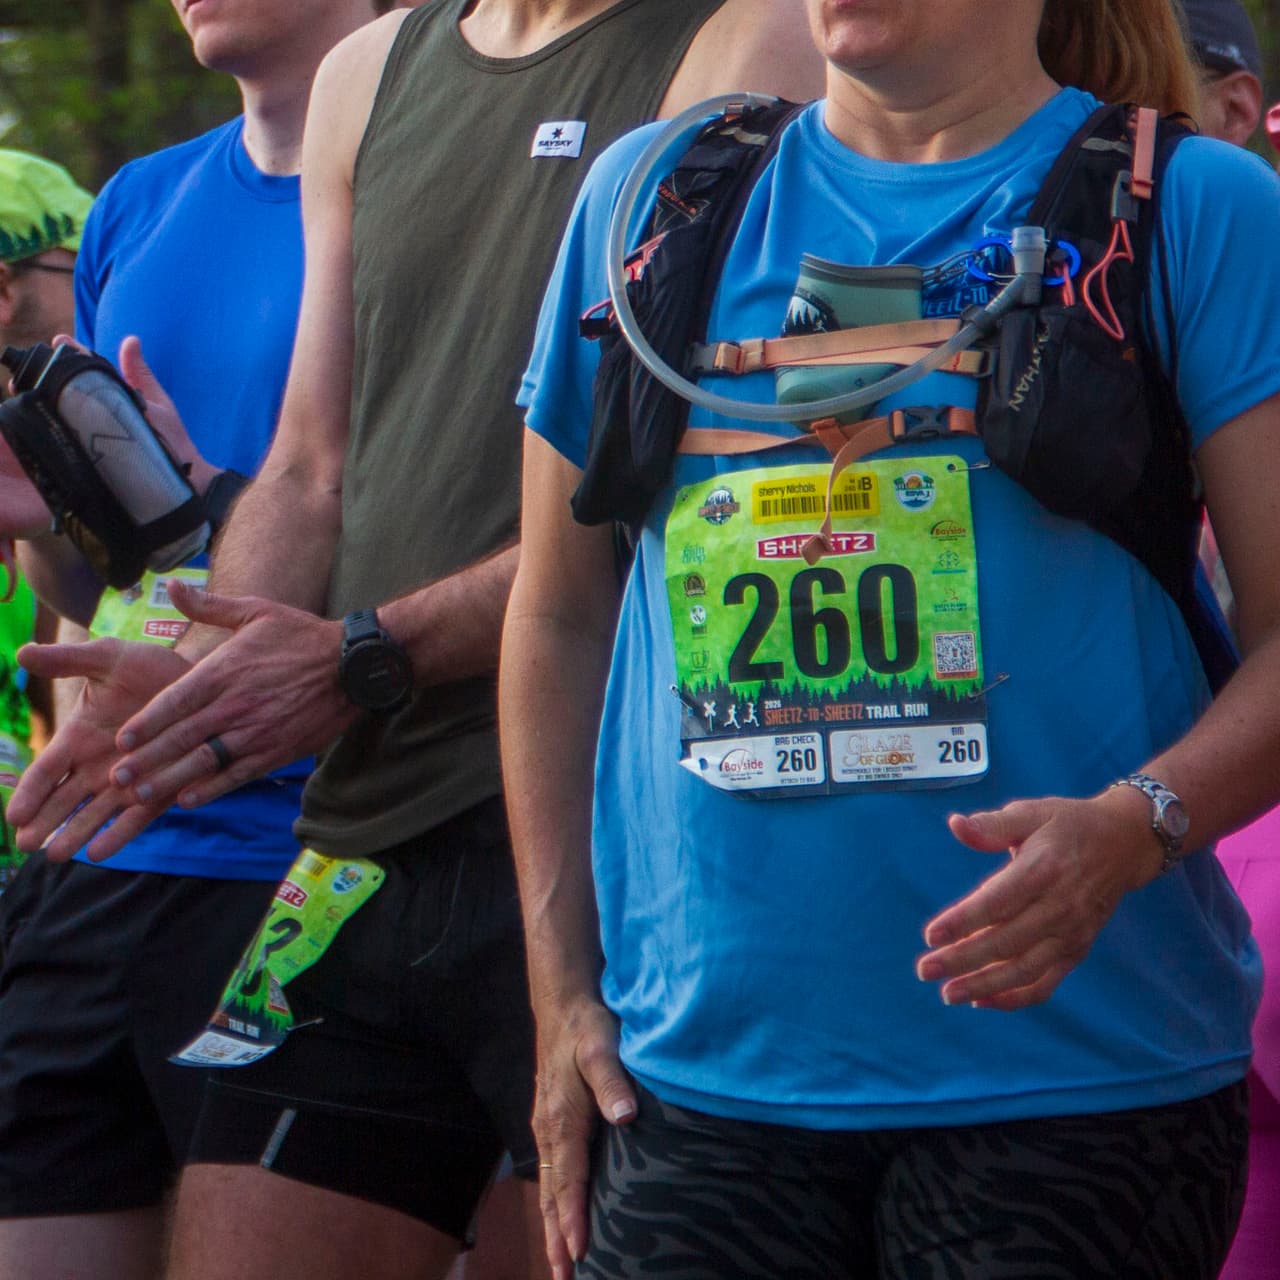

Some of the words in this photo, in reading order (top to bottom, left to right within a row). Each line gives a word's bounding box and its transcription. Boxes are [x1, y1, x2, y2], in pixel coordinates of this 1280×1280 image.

[759, 486, 785, 498] Sherry
[786, 483, 816, 494] Nichols
[764, 536, 868, 556] SHTZ
[148, 622, 184, 636] SHE
[723, 563, 919, 683] 260
[764, 704, 864, 726] SHEETZ-TO-SHEETZ
[865, 705, 901, 720] TRAIL
[904, 703, 929, 717] RUN
[774, 736, 791, 746] BAG
[792, 735, 816, 745] CHECK
[938, 738, 981, 763] 260
[724, 759, 764, 772] Bayside
[777, 748, 817, 773] 260
[860, 755, 874, 766] OF
[875, 752, 916, 766] GLORY
[278, 884, 305, 905] ETZ
